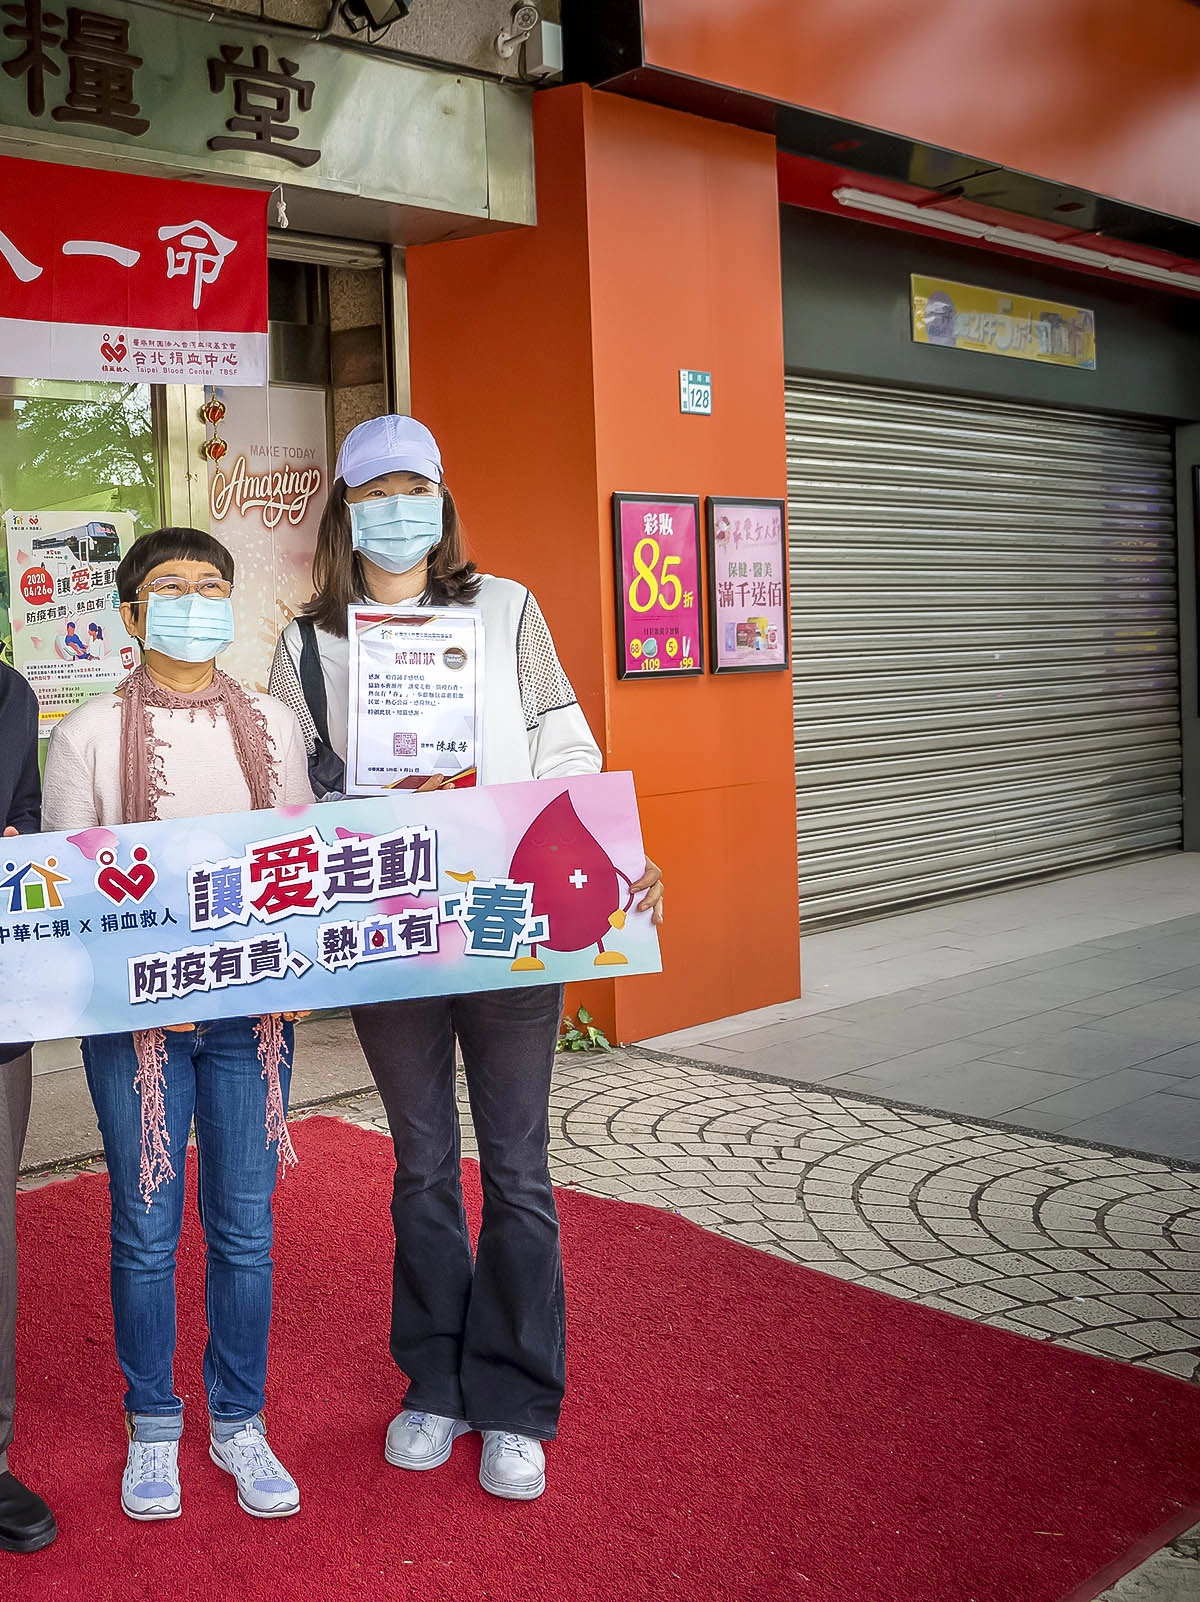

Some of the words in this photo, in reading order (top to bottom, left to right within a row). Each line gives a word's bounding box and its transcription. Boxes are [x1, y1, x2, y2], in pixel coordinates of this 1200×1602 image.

[132, 351, 238, 368] 台北捐血中心
[136, 366, 158, 374] Taipei
[163, 367, 184, 375] Blood
[220, 368, 238, 376] TBSF
[690, 388, 709, 408] 128
[250, 445, 280, 457] MAKE
[282, 447, 316, 459] TODAY
[211, 456, 321, 528] Amazing
[643, 512, 674, 536] 彩妝
[27, 573, 46, 585] 2020
[718, 581, 782, 608] 滿千送佰
[192, 827, 436, 925] 讓愛走動
[101, 907, 177, 933] 捐血救人
